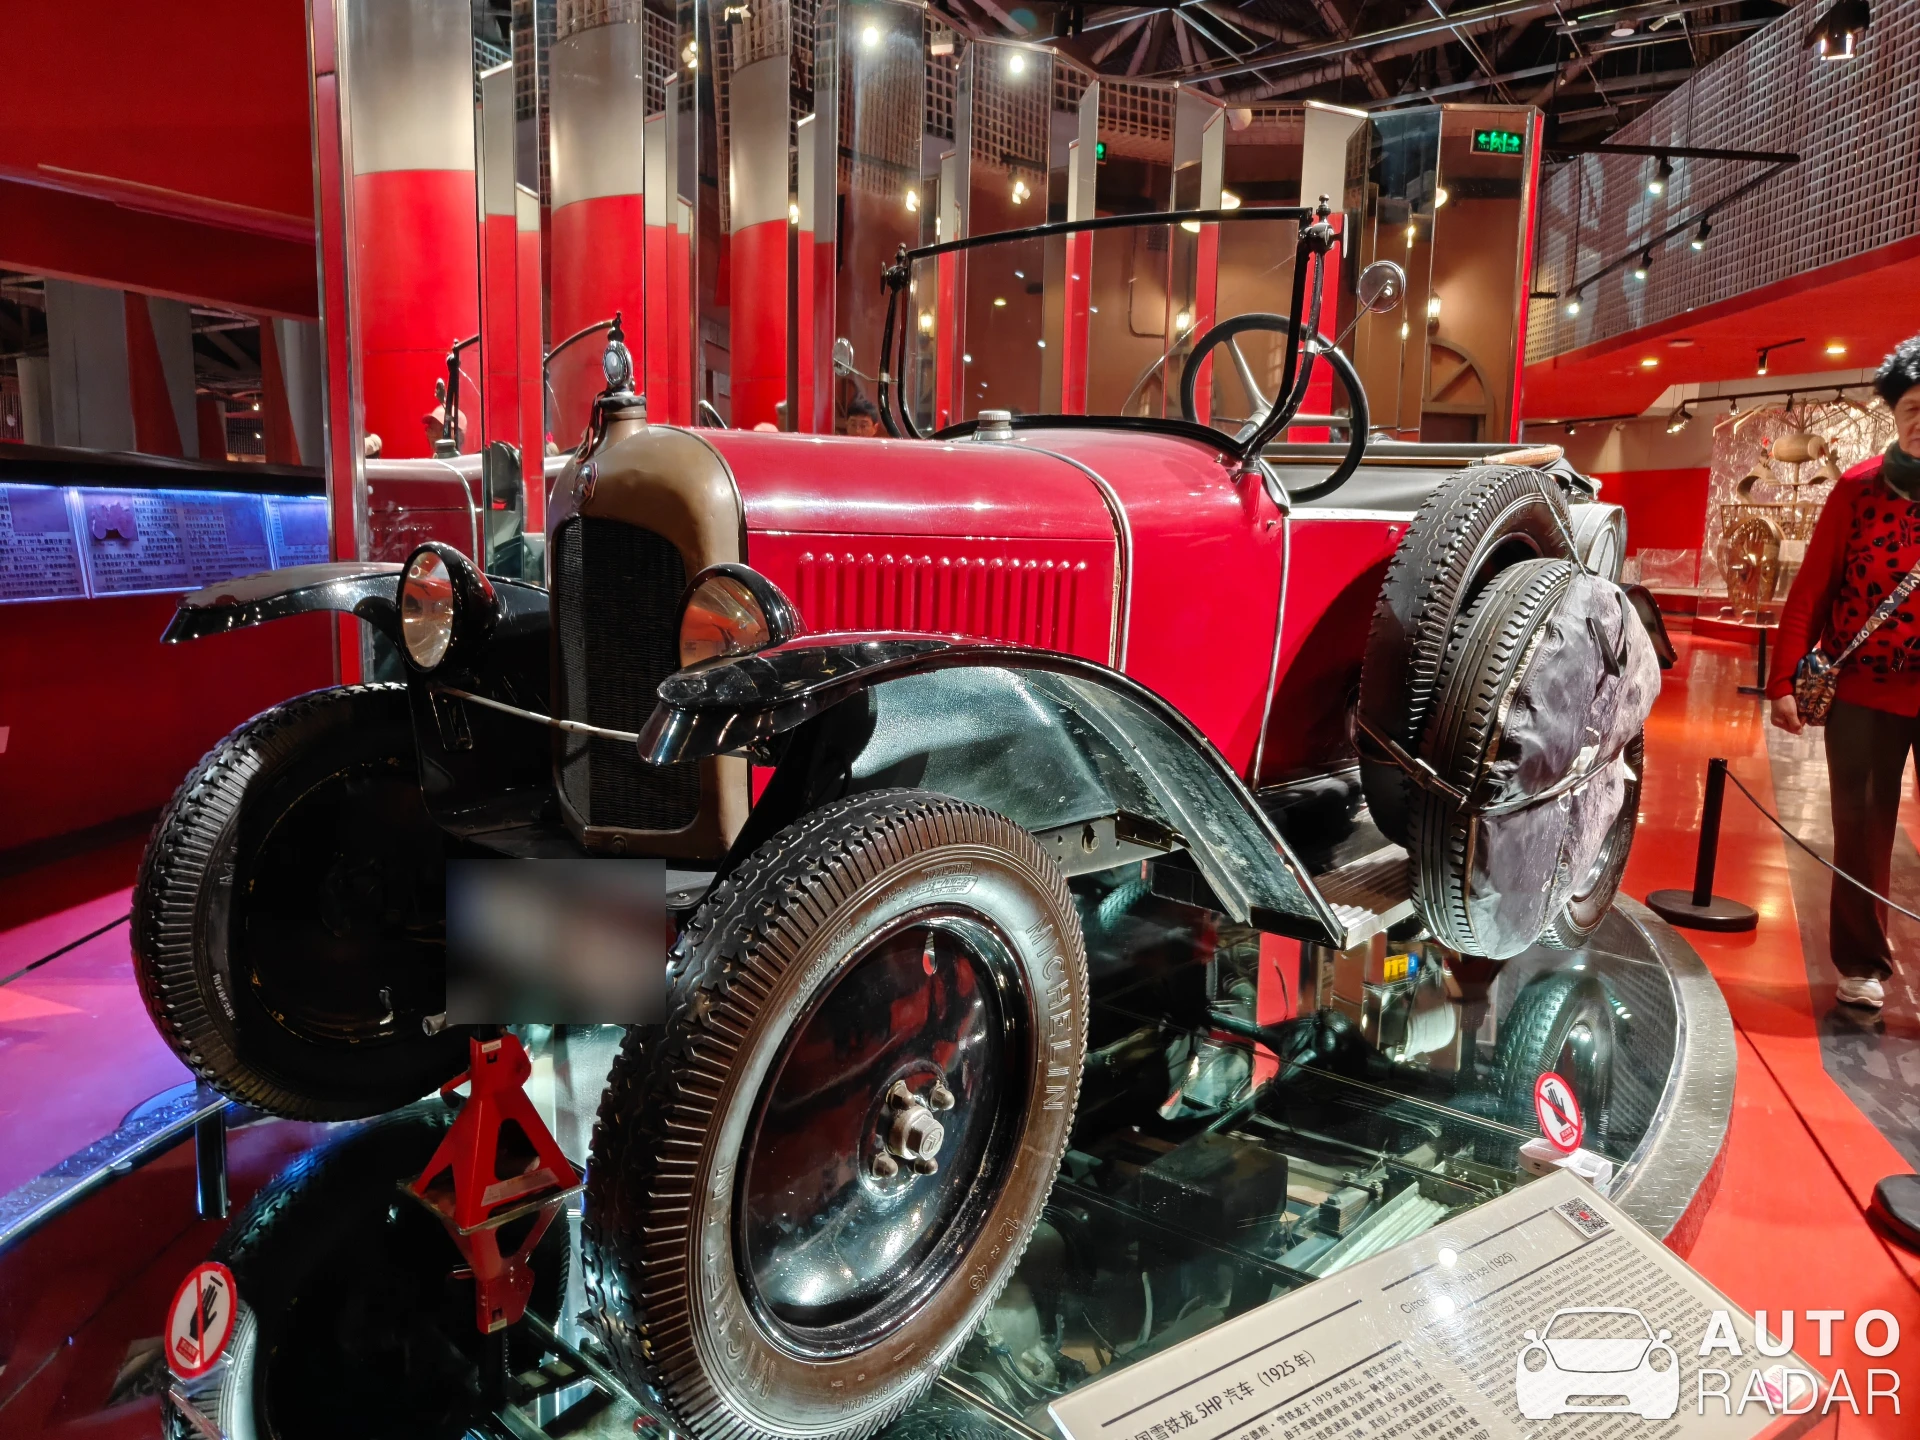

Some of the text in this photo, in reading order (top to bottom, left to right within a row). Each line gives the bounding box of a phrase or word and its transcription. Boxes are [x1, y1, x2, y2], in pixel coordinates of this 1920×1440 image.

[1024, 911, 1064, 1113] MICHELIN
[996, 1216, 1017, 1242] 12
[967, 1264, 987, 1296] 45
[1486, 1252, 1517, 1271] (1925)
[1510, 1289, 1524, 1298] was
[1521, 1276, 1546, 1291] founded
[1514, 1295, 1534, 1307] Being
[1539, 1283, 1554, 1292] first
[1551, 1274, 1571, 1286] female
[1569, 1269, 1580, 1277] car
[1578, 1264, 1591, 1272] due
[1603, 1244, 1627, 1259] simplicity
[1519, 1308, 1528, 1316] of
[1526, 1294, 1556, 1312] automotive
[1617, 1247, 1640, 1262] equipped
[1500, 1337, 1517, 1350] Over
[1584, 1291, 1603, 1302] being
[1599, 1277, 1624, 1294] launched
[1627, 1268, 1642, 1278] three
[1641, 1261, 1656, 1272] years
[1527, 1314, 1540, 1323] with
[1542, 1306, 1555, 1314] top
[1552, 1296, 1571, 1310] speed
[1568, 1292, 1576, 1300] of
[1592, 1277, 1604, 1287] and
[1601, 1272, 1614, 1281] fuel
[1612, 1257, 1642, 1276] consumption
[1604, 1287, 1688, 1339] of the world This service mode
[1658, 1311, 1669, 1319] use
[1675, 1294, 1696, 1308] various
[1671, 1306, 1697, 1322] legendary
[1694, 1301, 1703, 1309] car
[1467, 1370, 1481, 1381] and
[1480, 1355, 1509, 1376] prompted
[1506, 1350, 1517, 1359] the
[1596, 1299, 1608, 1307] the
[1606, 1288, 1629, 1302] company
[1626, 1282, 1637, 1290] set
[1645, 1266, 1664, 1279] special
[1476, 1372, 1504, 1390] research
[1500, 1366, 1513, 1376] lab
[1588, 1316, 1600, 1324] the
[1627, 1293, 1638, 1301] set
[1635, 1289, 1643, 1297] of
[1641, 1273, 1671, 1293] standardized
[1484, 1382, 1508, 1398] service
[1597, 1316, 1618, 1331] manual
[1645, 1291, 1661, 1302] which
[1658, 1284, 1671, 1294] laid
[1311, 1390, 1333, 1406] 1919
[1385, 1353, 1402, 1366] 5HP
[1383, 1391, 1396, 1402] 60
[1517, 1425, 1528, 1433] in
[1524, 1418, 1537, 1428] the
[1688, 1315, 1700, 1324] Car
[1539, 1425, 1550, 1433] in
[1671, 1335, 1689, 1348] world,
[1600, 1420, 1624, 1439] journey
[1620, 1413, 1629, 1423] of
[1716, 1347, 1727, 1358] the
[1133, 1410, 1198, 1440] 国雪铁龙
[1194, 1395, 1225, 1418] 5HP
[1374, 1396, 1455, 1440] 术研究实验室进行技术
[1567, 1412, 1587, 1430] Hamm
[1574, 1429, 1587, 1439] the
[1585, 1411, 1614, 1432] historical
[1681, 1403, 1690, 1411] on
